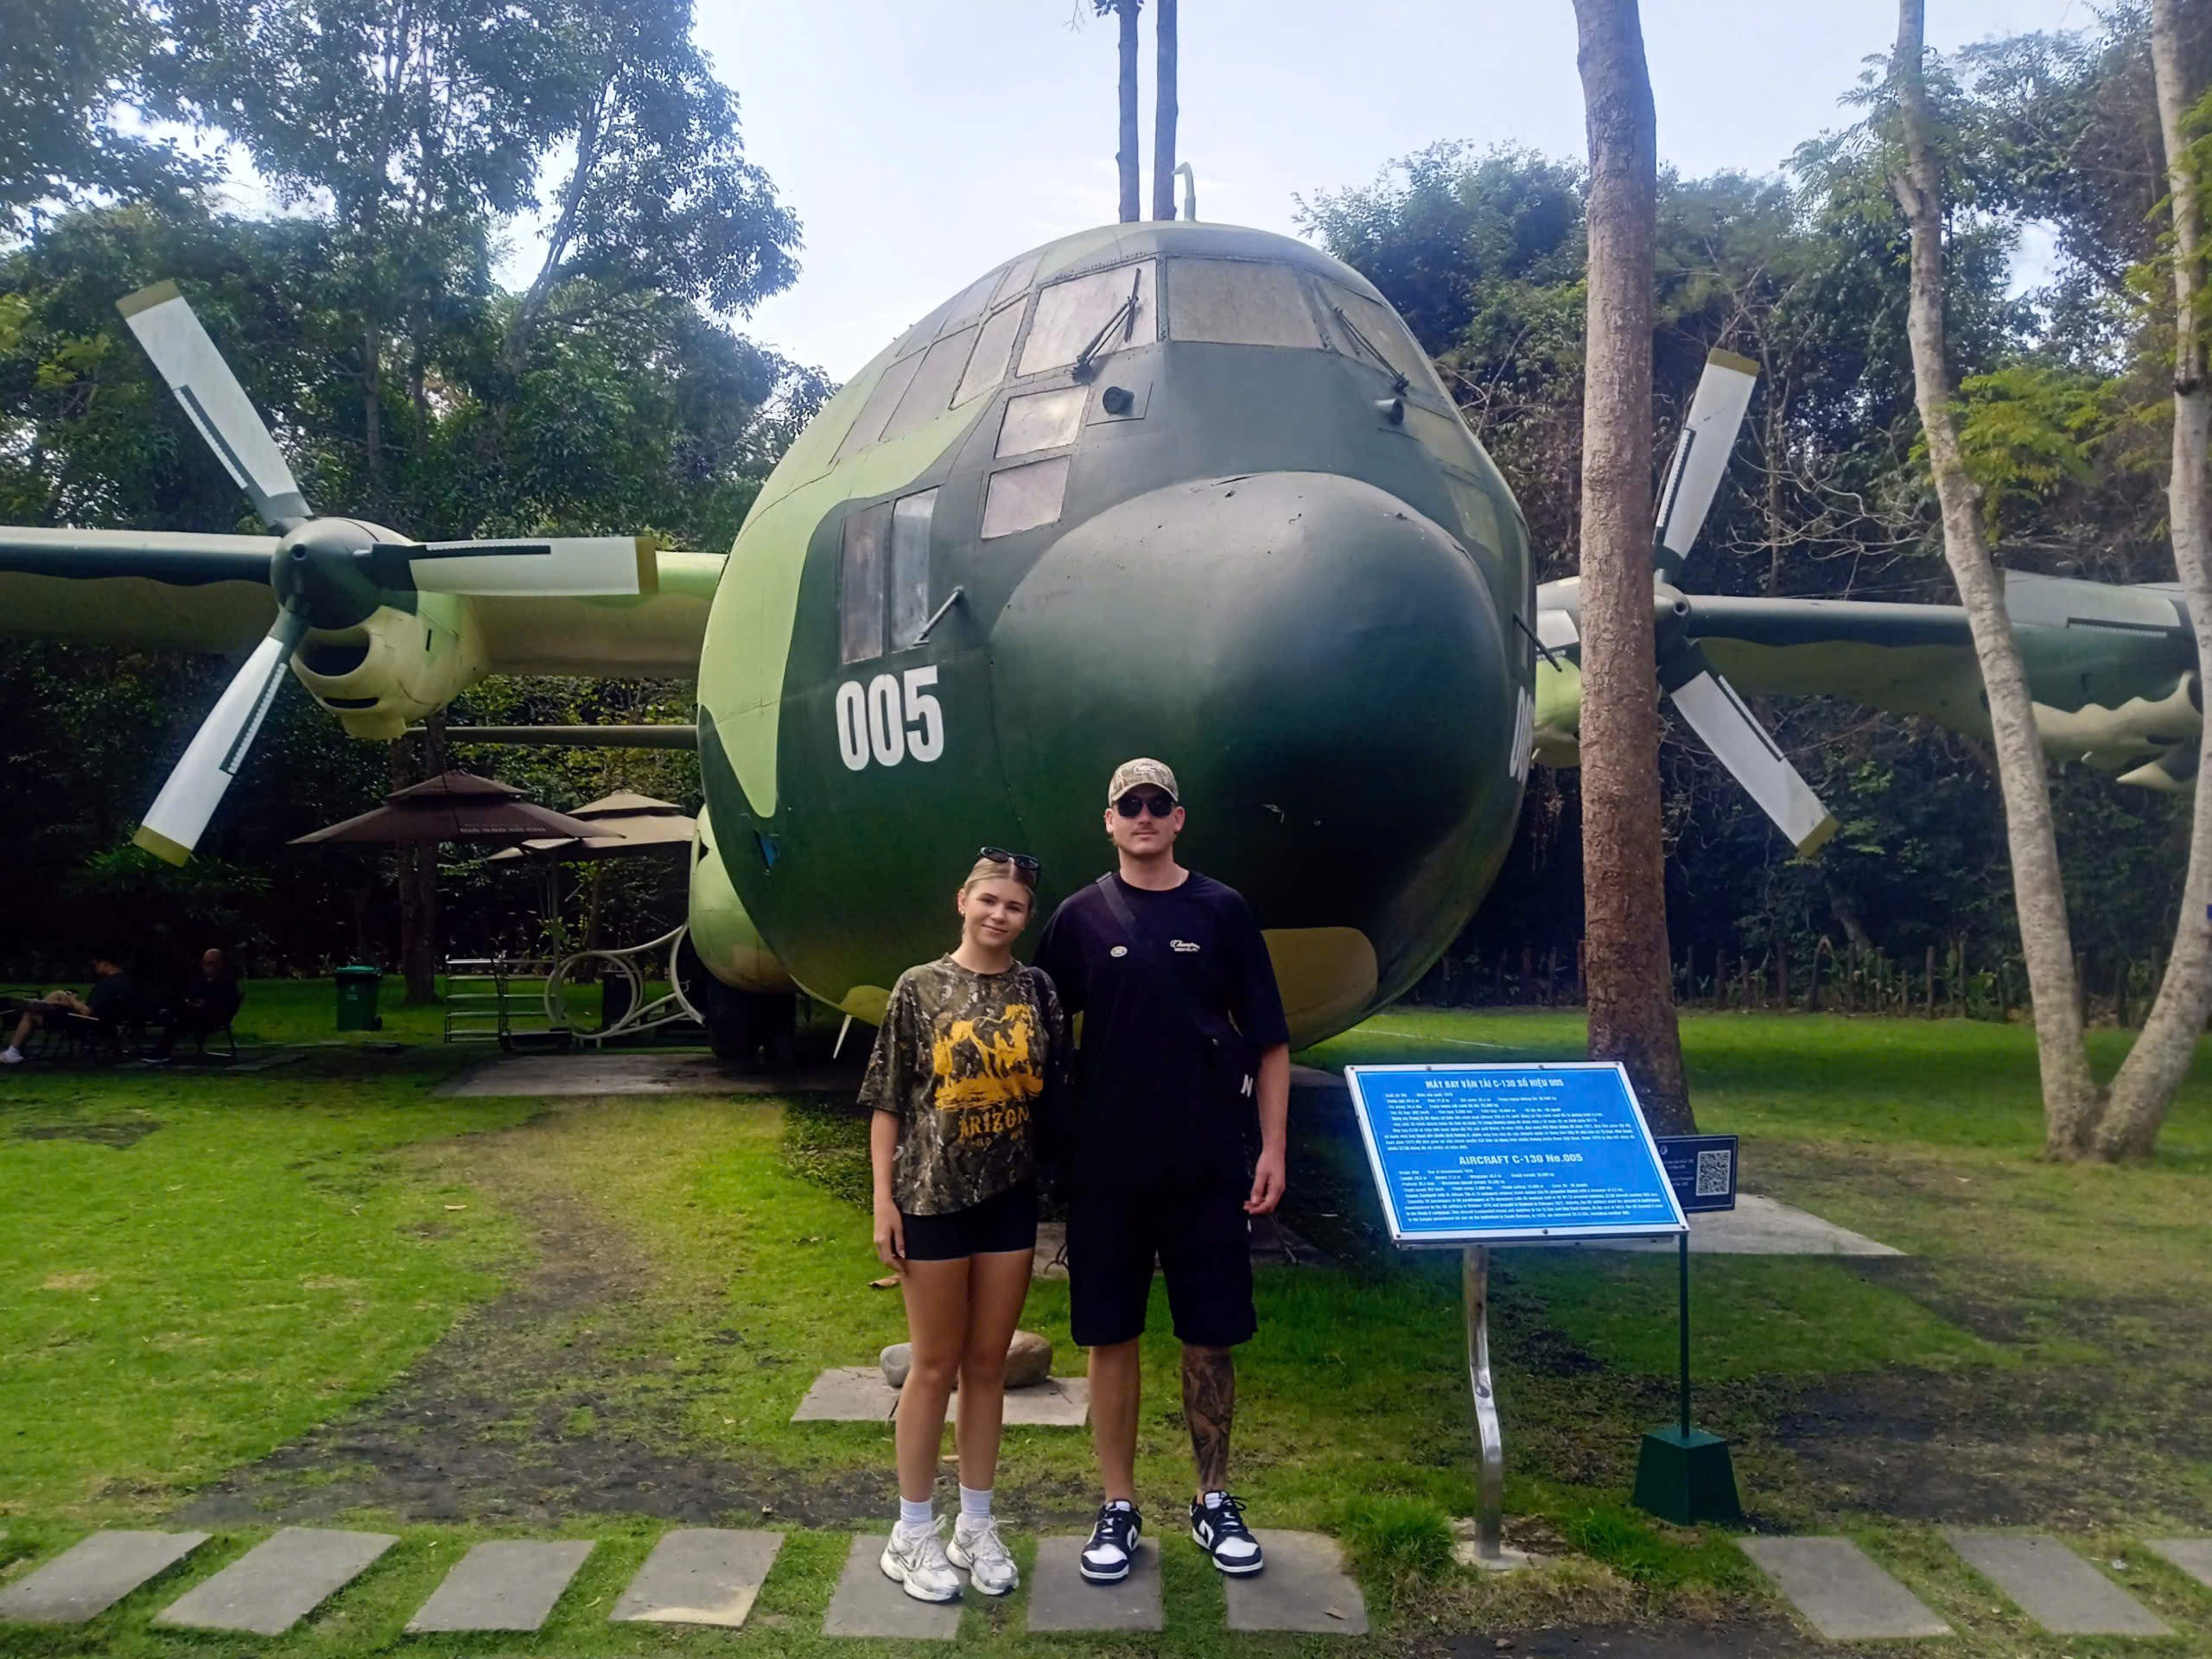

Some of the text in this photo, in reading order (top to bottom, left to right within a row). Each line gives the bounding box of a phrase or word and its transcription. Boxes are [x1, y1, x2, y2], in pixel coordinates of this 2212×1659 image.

[836, 664, 944, 771] 005
[1445, 1080, 1459, 1089] BAY
[1492, 1079, 1516, 1088] C-130
[1548, 1078, 1565, 1087] 005
[1459, 1154, 1584, 1165] AIRCRAFT C-130 No.005
